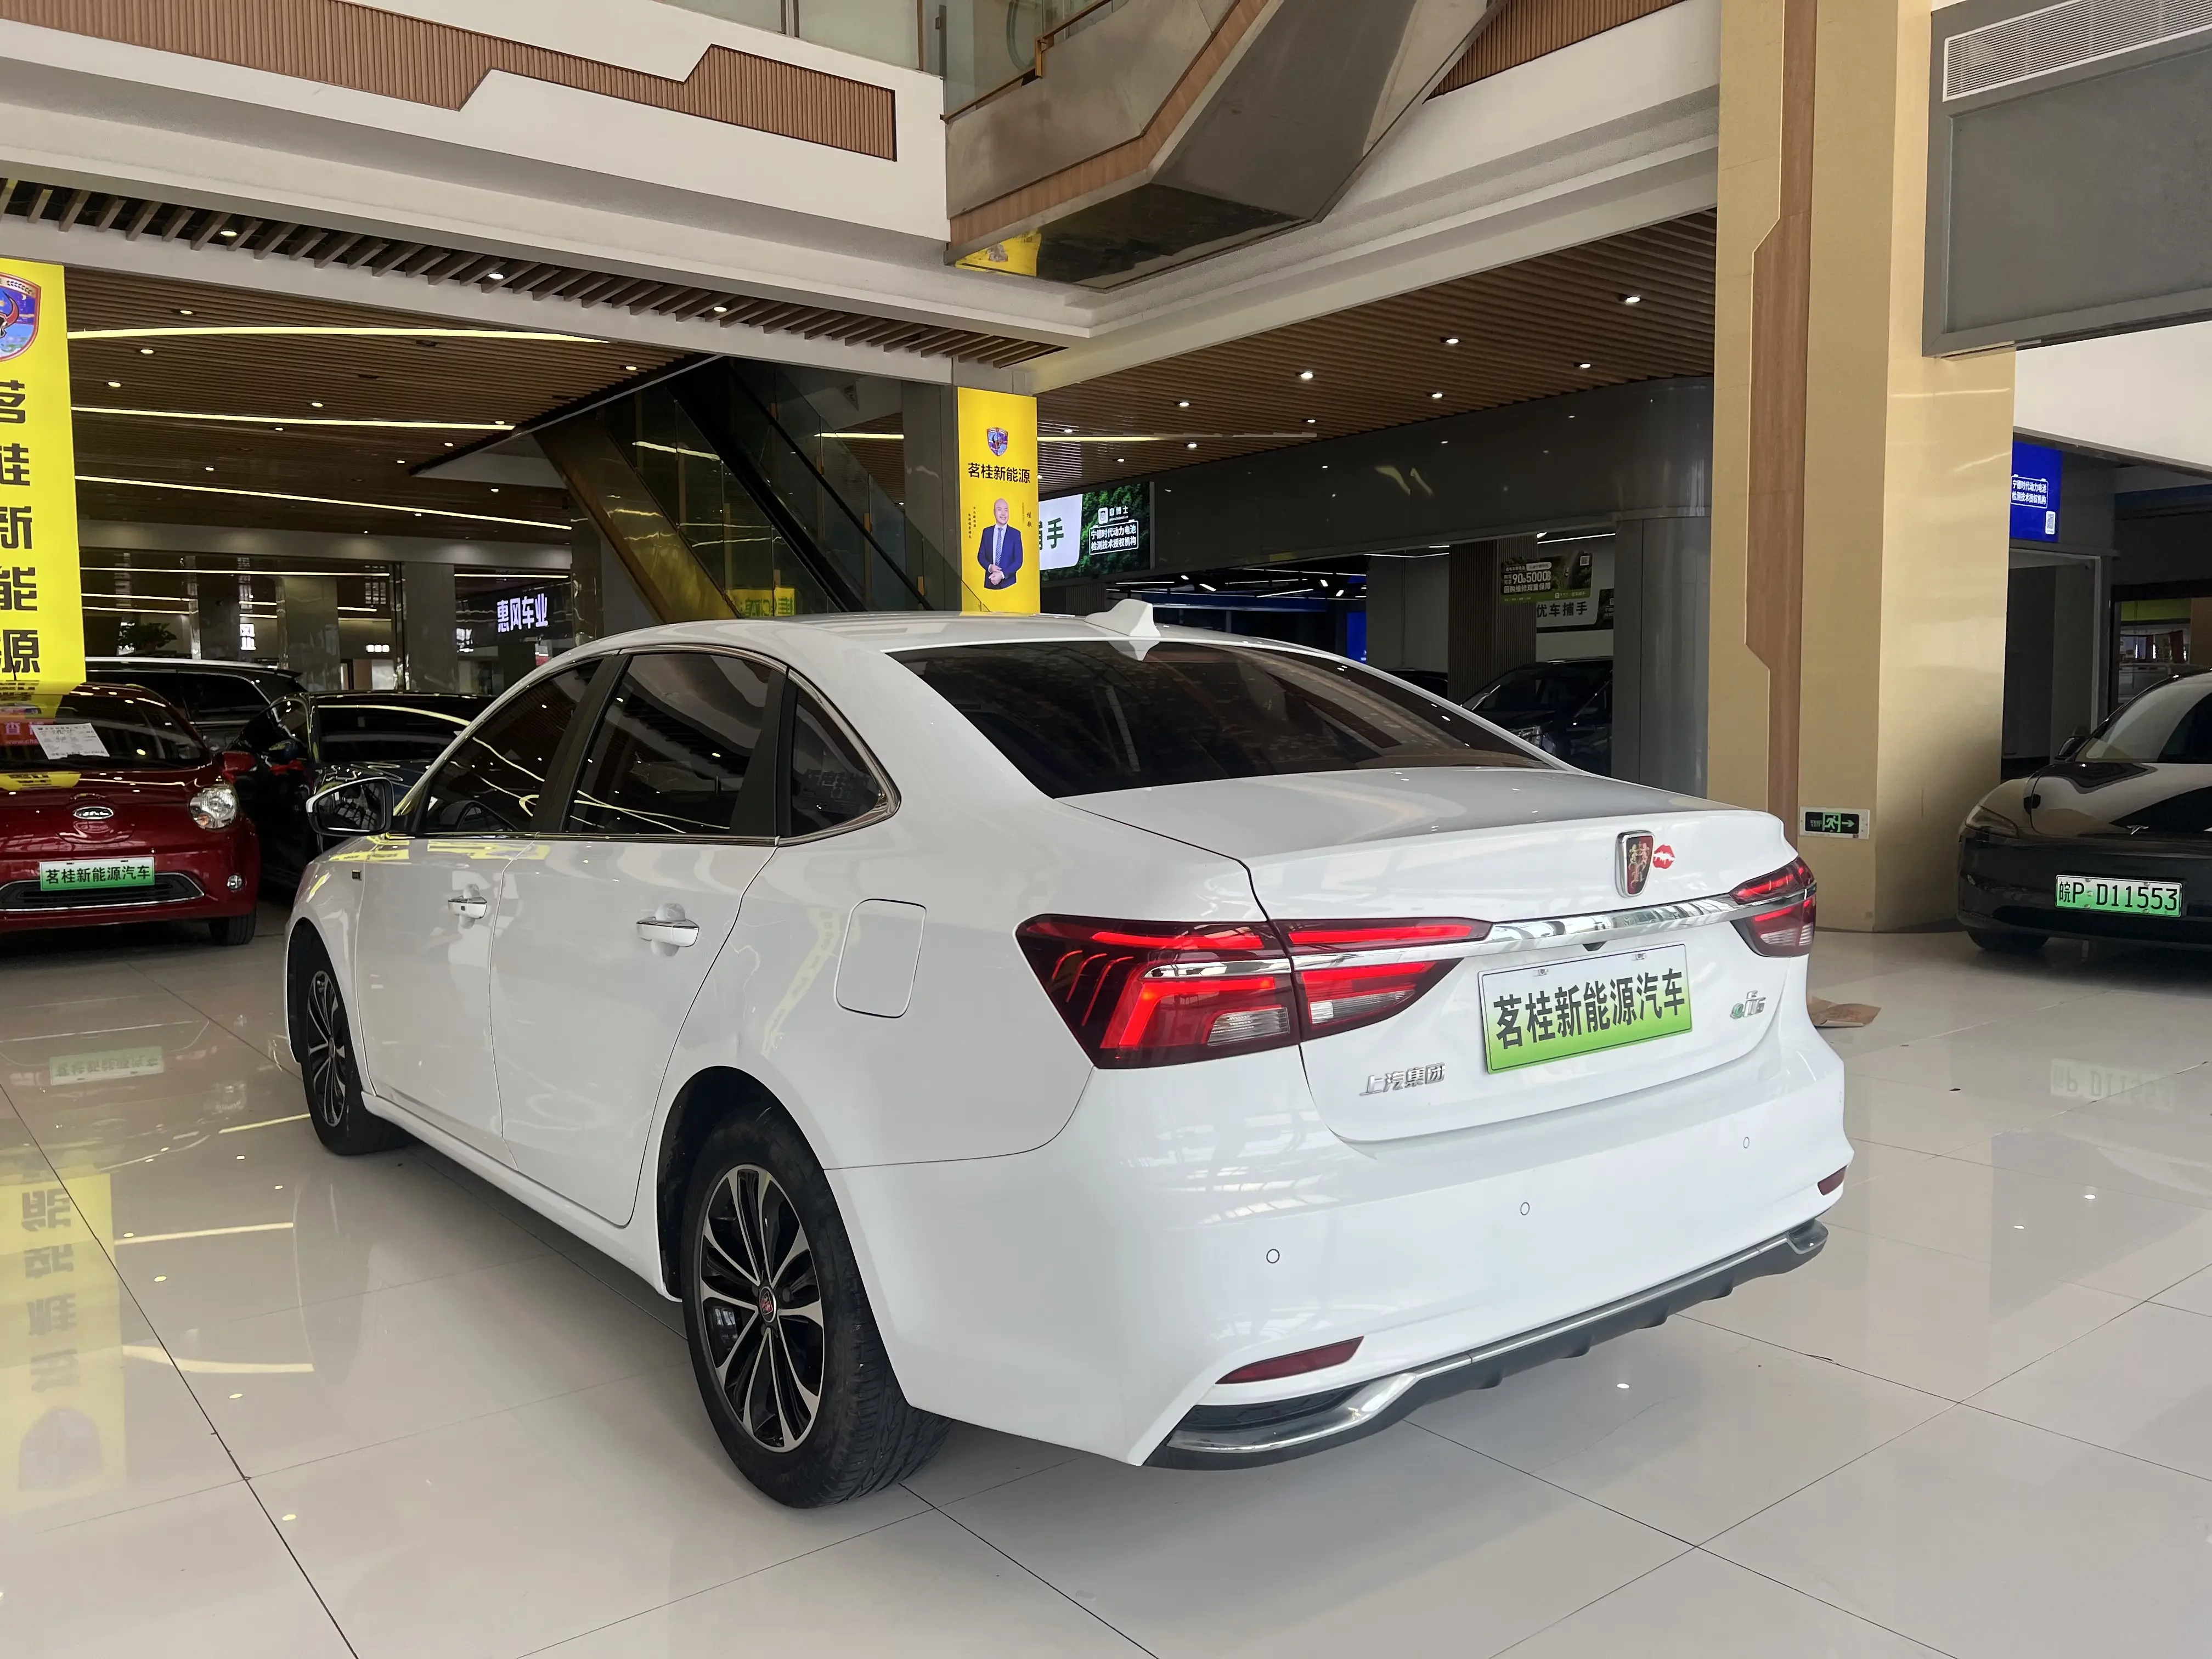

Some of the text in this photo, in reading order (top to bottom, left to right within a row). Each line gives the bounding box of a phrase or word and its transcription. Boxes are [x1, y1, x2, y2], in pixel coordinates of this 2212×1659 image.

[968, 462, 1031, 484] 茗桂新能源
[1091, 524, 1137, 540] 宁德时代动力电池
[1091, 535, 1137, 551] 检测技术授权机构
[496, 593, 549, 633] 惠风车业
[1537, 601, 1587, 618] 优车捕手
[46, 865, 150, 884] 茗桂新能源汽车
[1493, 968, 1685, 1049] 茗桂新能源汽车
[1359, 1062, 1446, 1096] 上汽集团
